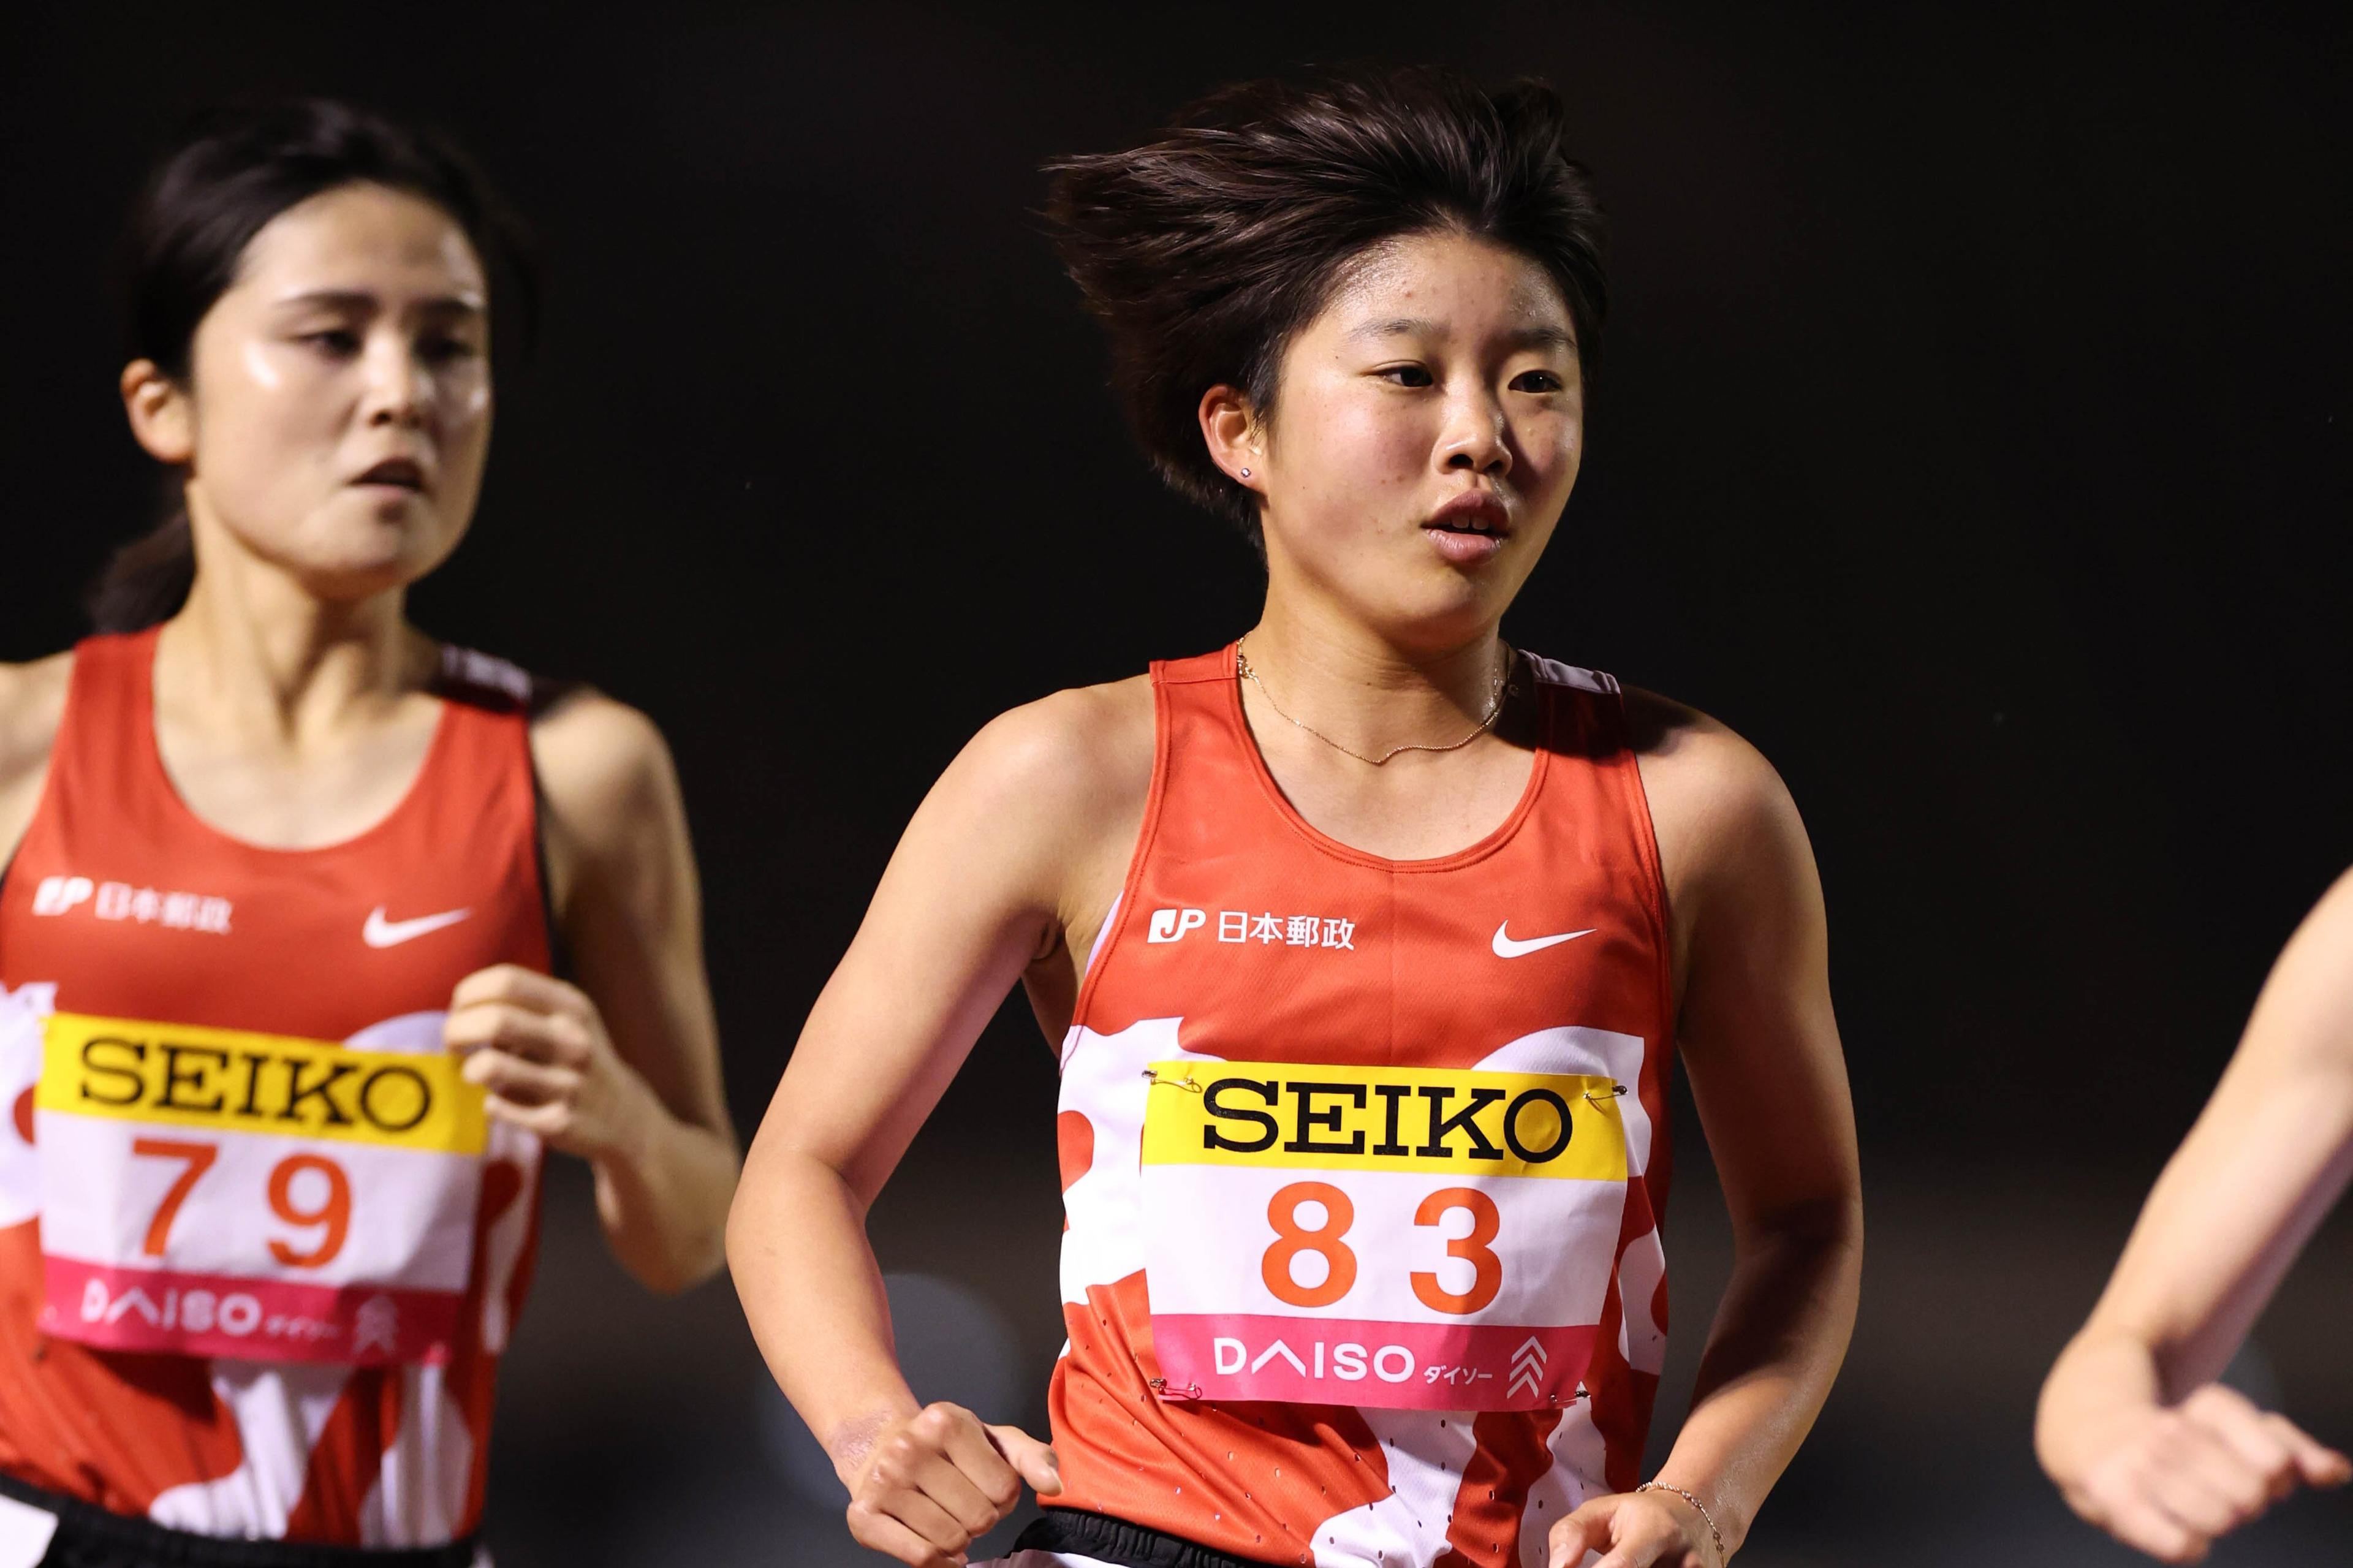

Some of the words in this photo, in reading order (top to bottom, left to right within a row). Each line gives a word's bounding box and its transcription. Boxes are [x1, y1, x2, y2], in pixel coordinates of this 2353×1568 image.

[1147, 909, 1207, 943] JP
[1218, 911, 1355, 950] 日本郵政
[80, 1037, 431, 1132] SEIKO
[1203, 1078, 1574, 1163] SEIKO
[133, 1138, 352, 1269] 79
[1261, 1181, 1502, 1315] 83
[1213, 1337, 1415, 1383] DAISO
[1423, 1365, 1493, 1385] ダイソー
